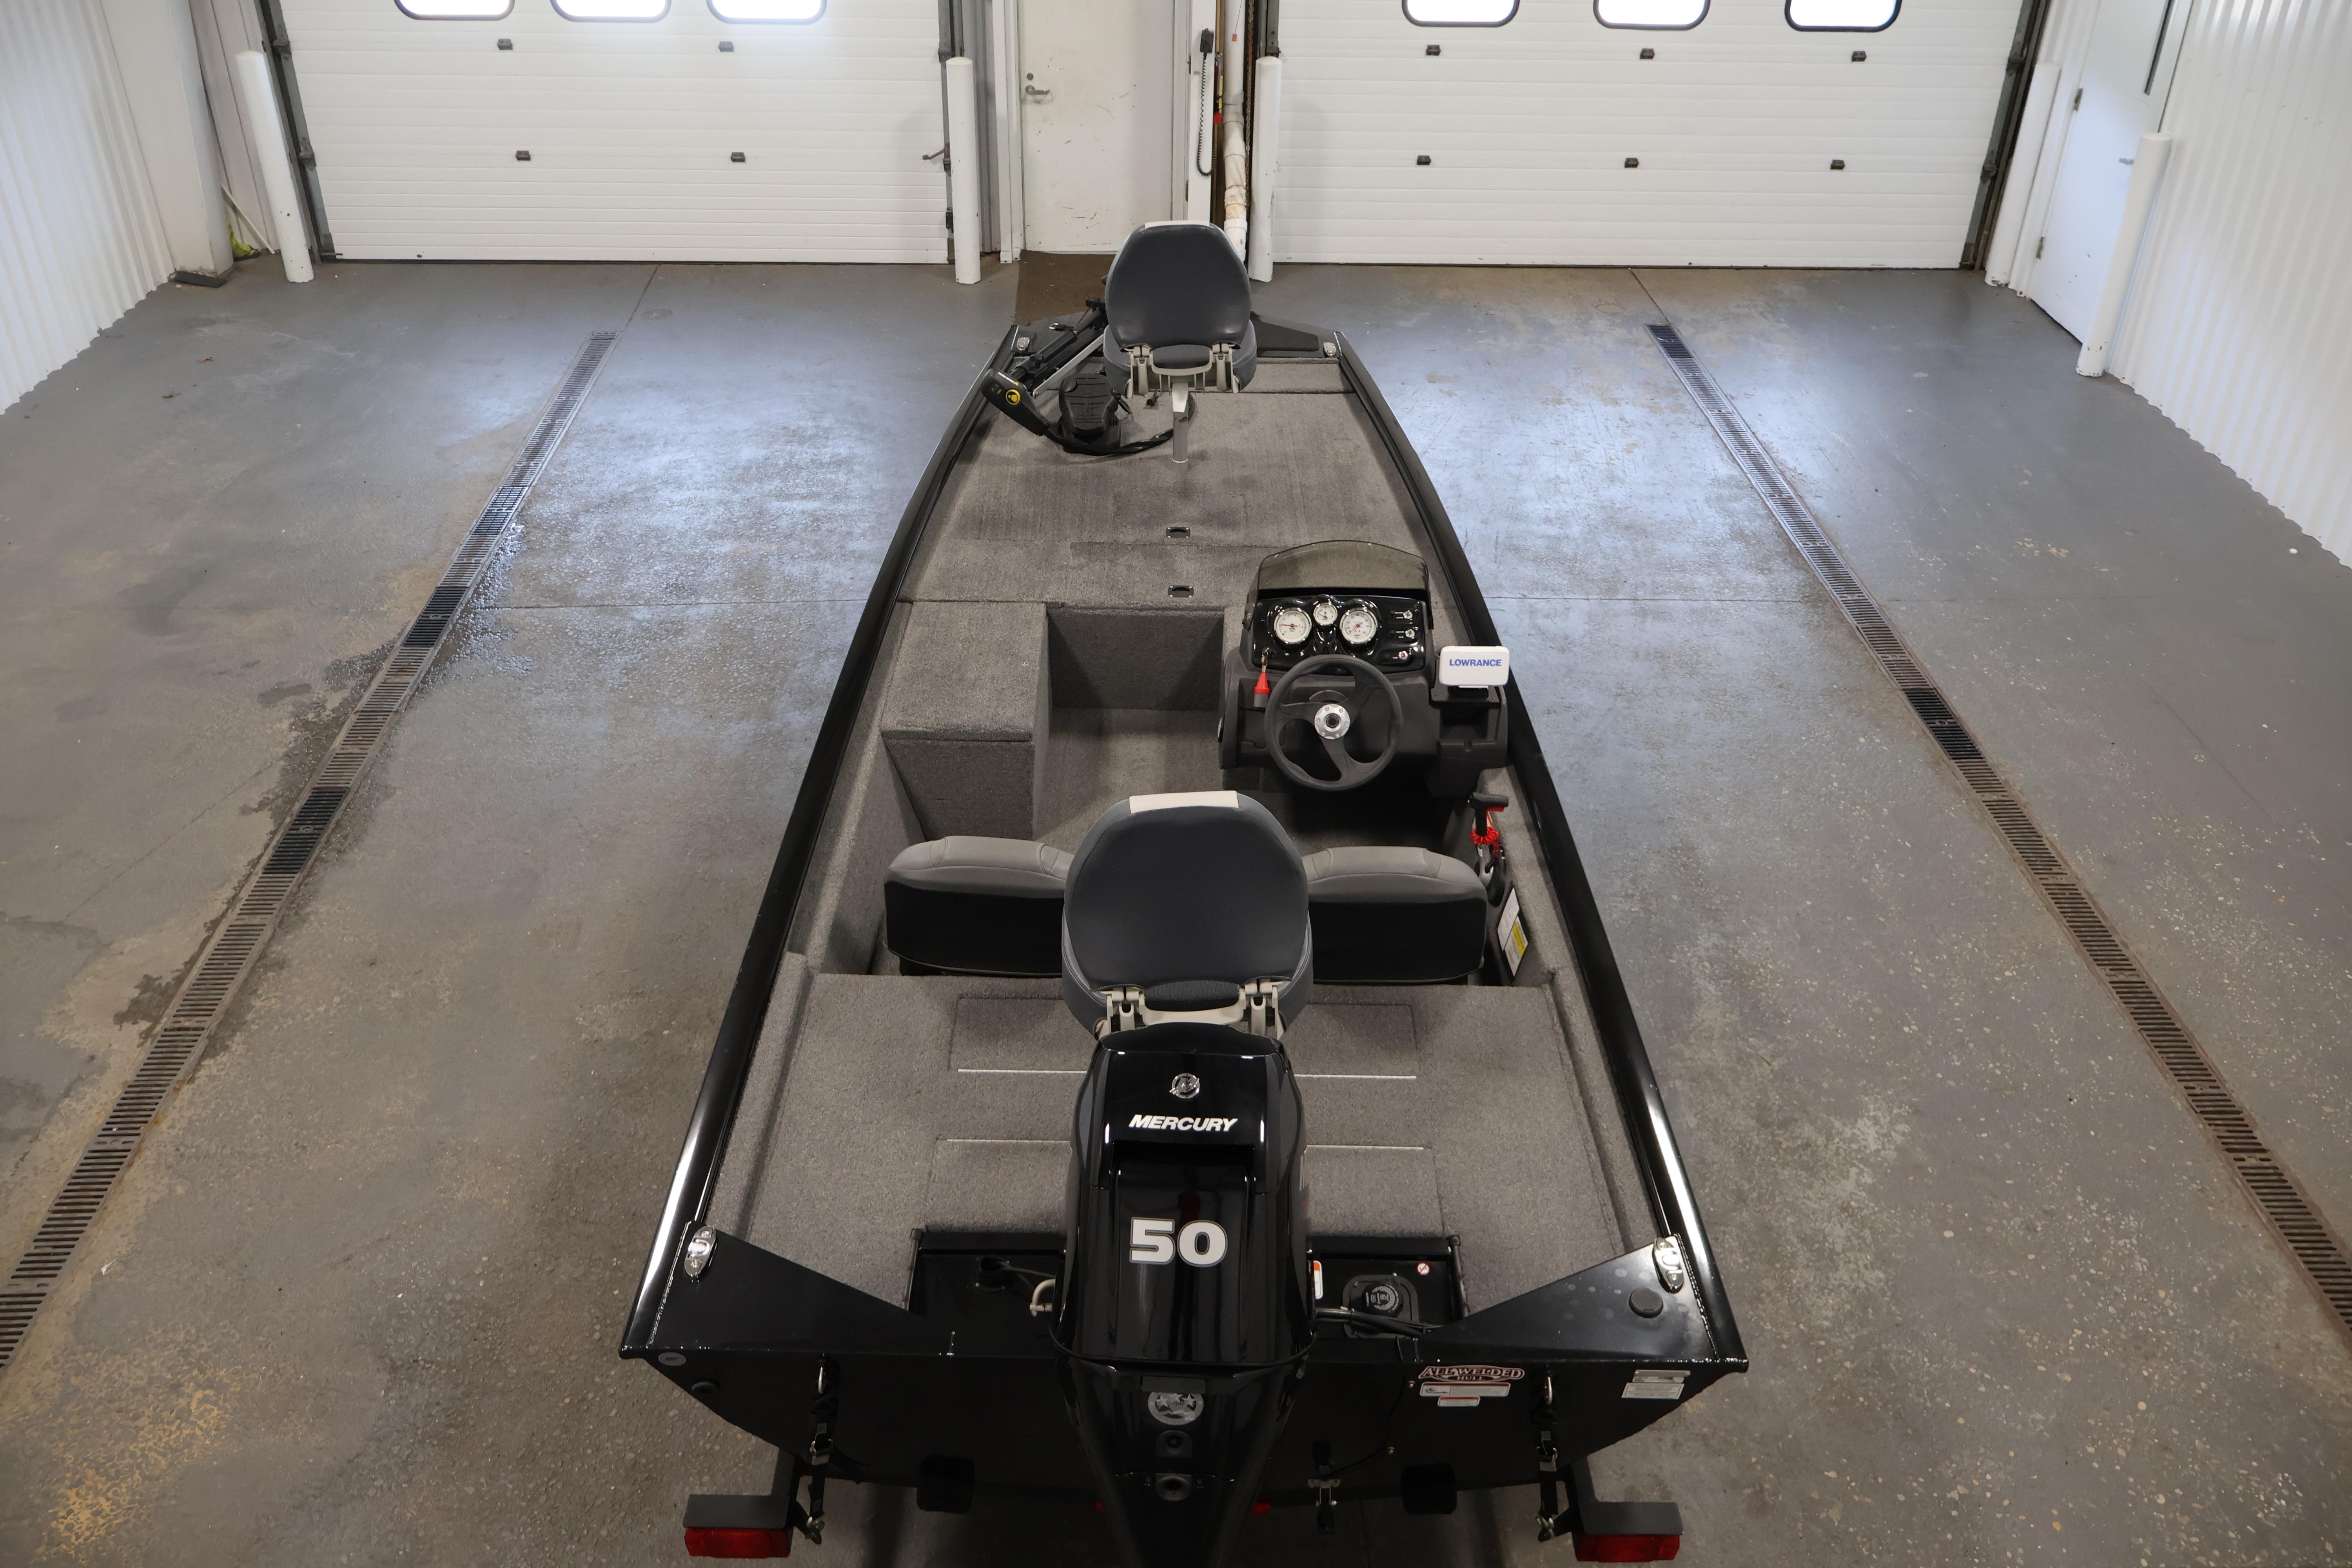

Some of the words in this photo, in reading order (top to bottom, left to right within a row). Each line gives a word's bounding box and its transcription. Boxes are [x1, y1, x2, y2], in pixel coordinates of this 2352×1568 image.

[1129, 1114, 1238, 1132] MERCURY
[1129, 1216, 1228, 1267] 50
[1423, 1367, 1456, 1376] ALL
[1456, 1368, 1522, 1378] WELDED
